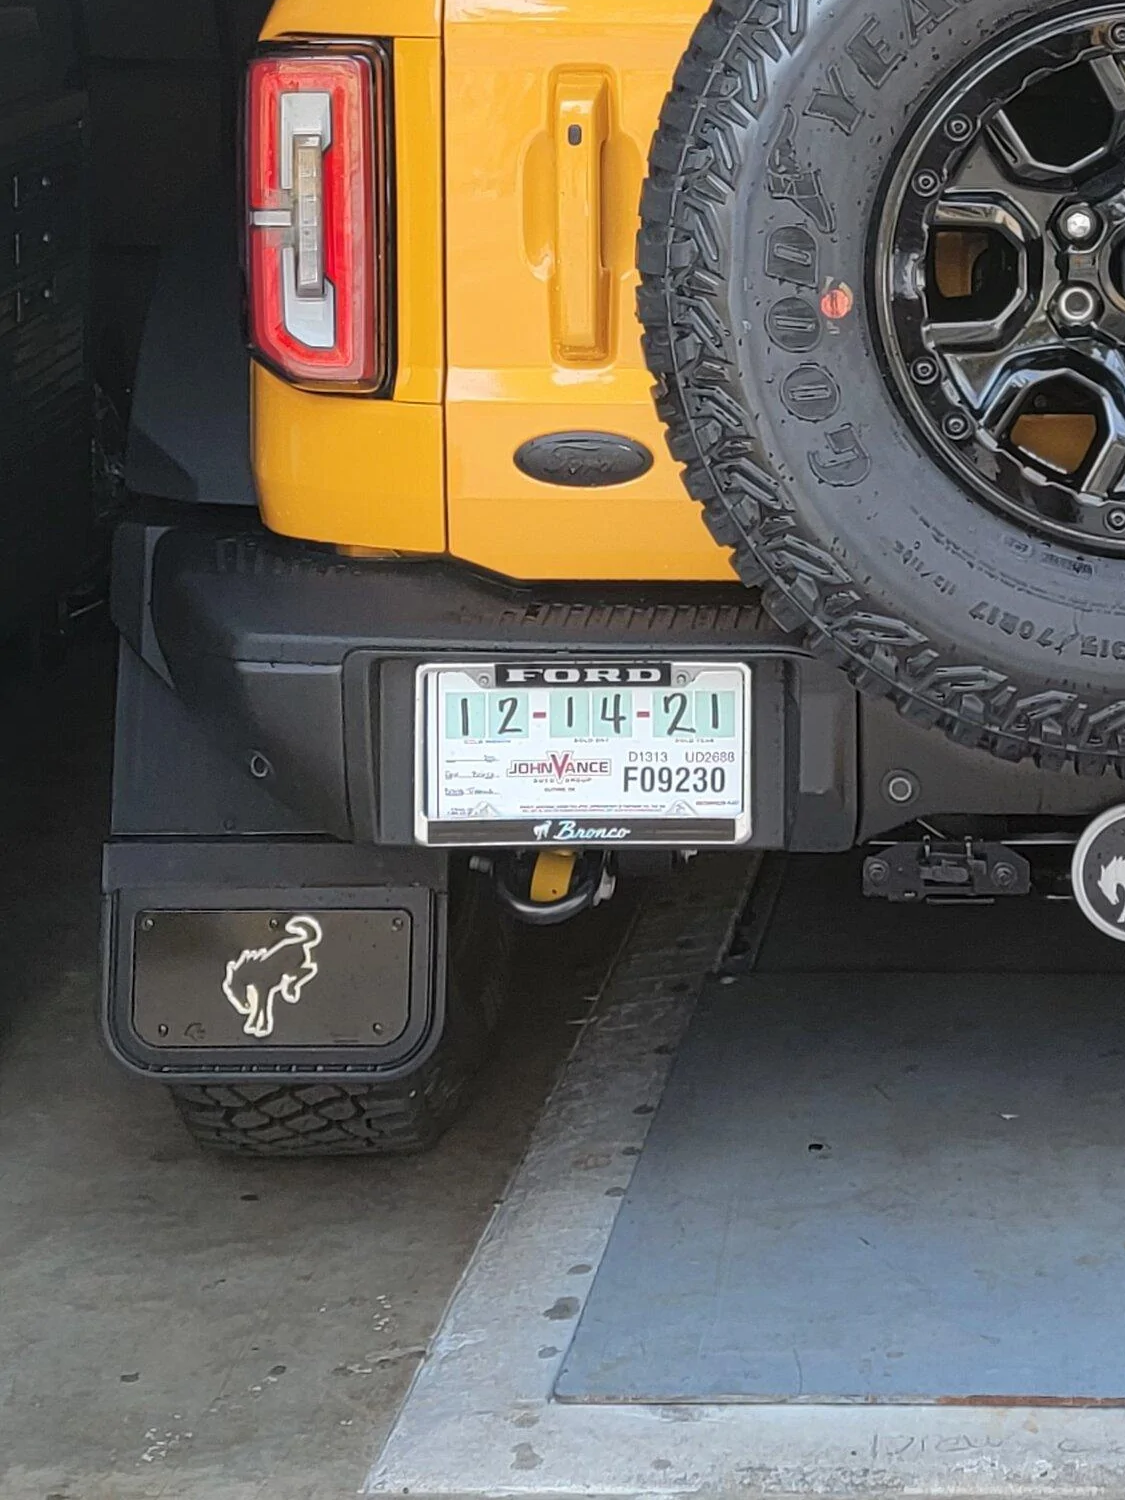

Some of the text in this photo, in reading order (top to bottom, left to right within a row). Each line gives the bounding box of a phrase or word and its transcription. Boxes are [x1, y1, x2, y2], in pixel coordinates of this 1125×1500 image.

[506, 668, 661, 683] FORD
[628, 751, 668, 762] D1313
[623, 766, 726, 793] F09230
[553, 820, 631, 840] Bronco
